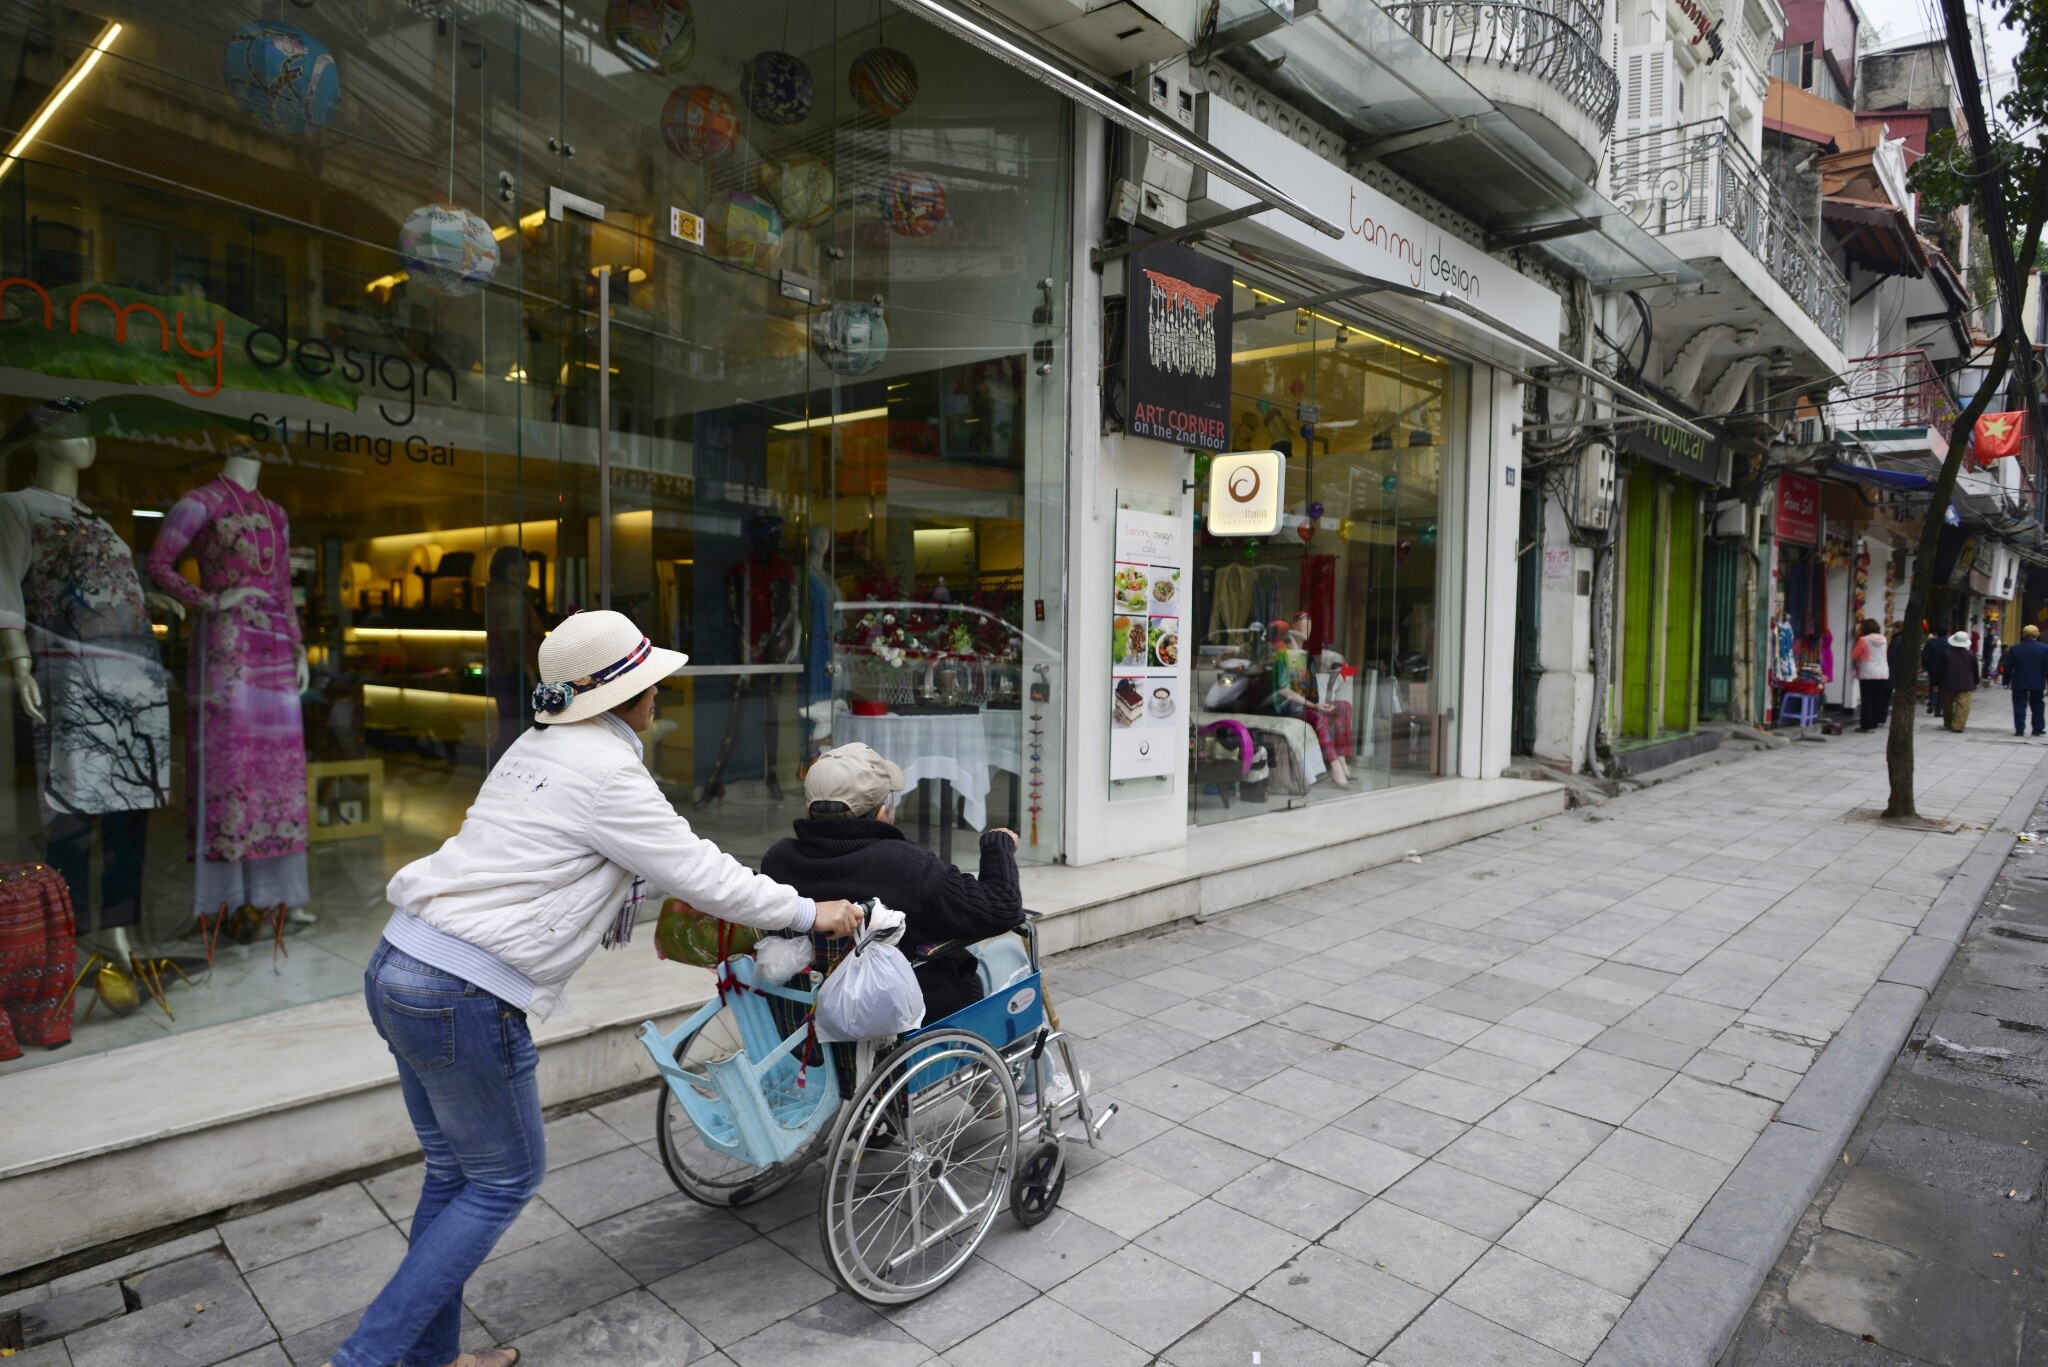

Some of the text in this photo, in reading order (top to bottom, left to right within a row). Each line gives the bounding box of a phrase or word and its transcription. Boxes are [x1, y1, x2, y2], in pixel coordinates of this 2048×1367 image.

[1350, 185, 1480, 300] tanmy design
[245, 294, 457, 426] design
[248, 412, 456, 467] 61 Hang Gai
[1134, 402, 1225, 438] ART CORNER
[1134, 419, 1225, 450] on the 2nd floor
